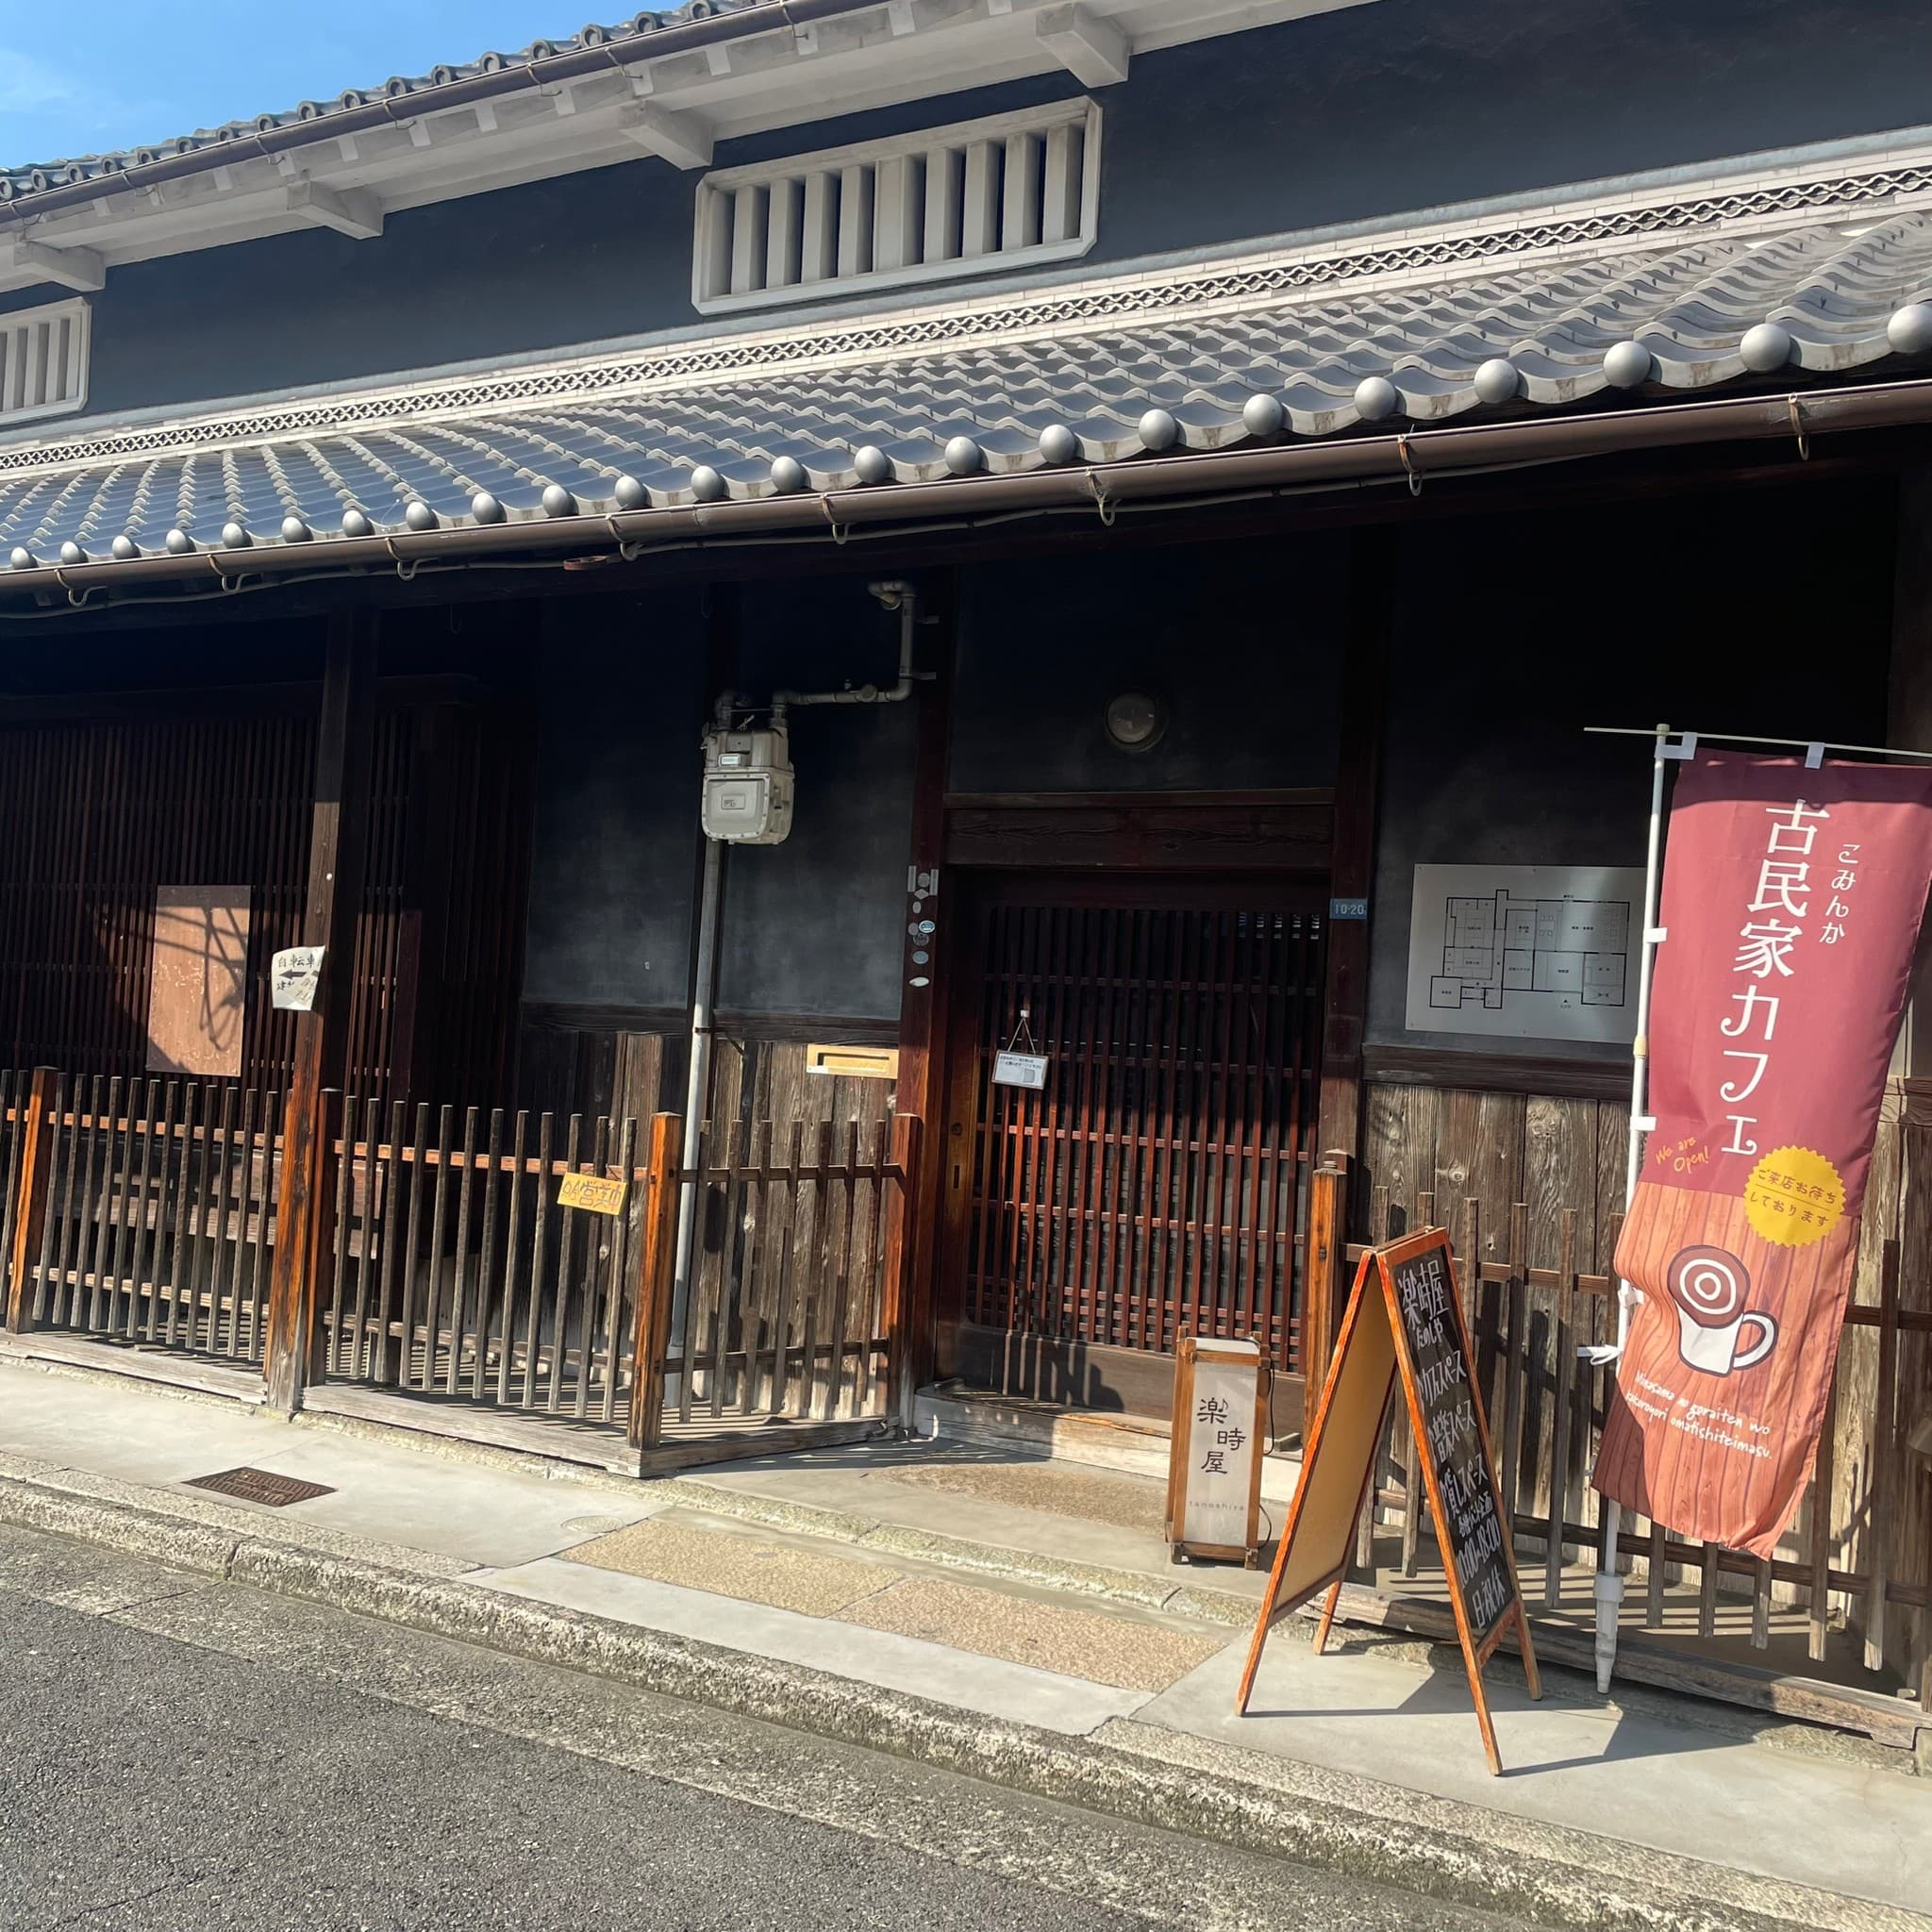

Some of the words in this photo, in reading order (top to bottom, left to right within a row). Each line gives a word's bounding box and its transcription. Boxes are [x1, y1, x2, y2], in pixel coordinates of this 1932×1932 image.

[1819, 843, 1860, 944] こみんか
[1720, 798, 1830, 1156] 古民家カフェ
[1656, 1145, 1673, 1165] We
[1677, 1137, 1696, 1151] are
[1674, 1145, 1708, 1174] Open!
[1758, 1169, 1836, 1204] ご来店お待ち
[1750, 1191, 1828, 1226] しております
[1397, 1259, 1449, 1330] 楽時屋
[1416, 1317, 1443, 1351] たのしや
[1196, 1397, 1246, 1474] 楽時屋
[1686, 1404, 1743, 1428] goraiten
[1749, 1422, 1771, 1435] wo
